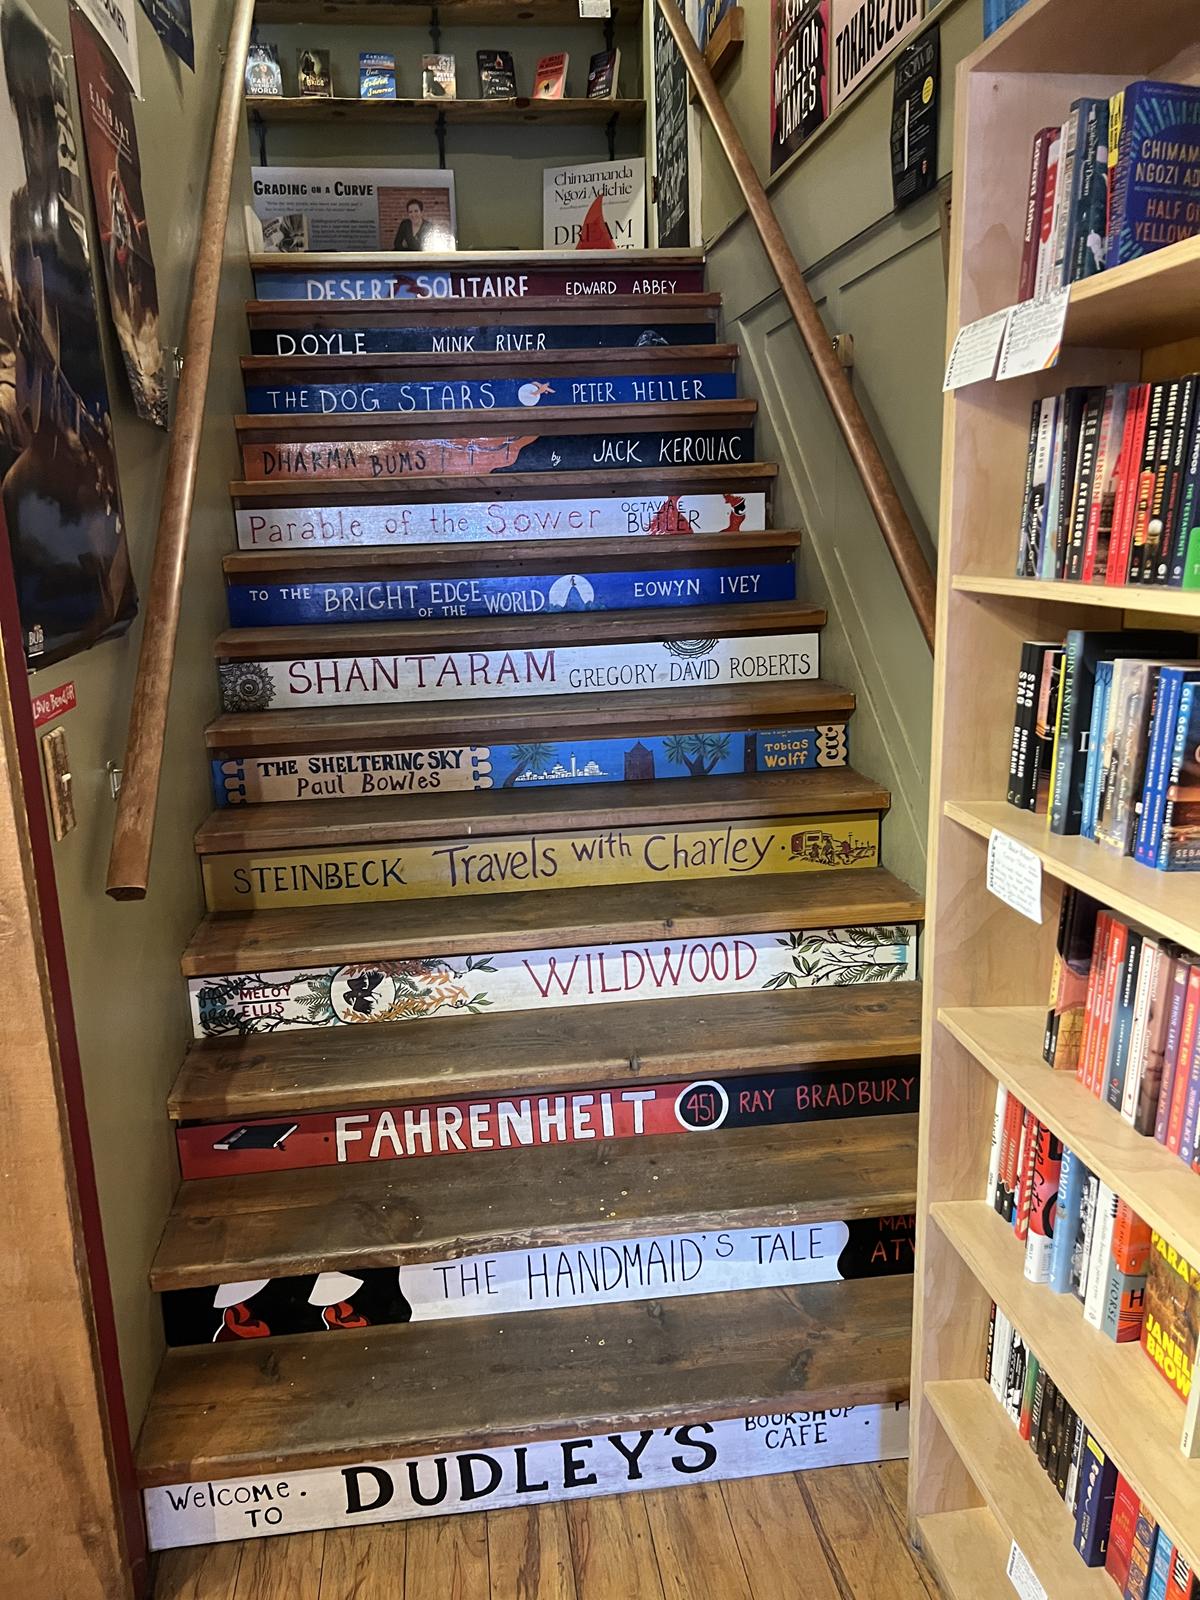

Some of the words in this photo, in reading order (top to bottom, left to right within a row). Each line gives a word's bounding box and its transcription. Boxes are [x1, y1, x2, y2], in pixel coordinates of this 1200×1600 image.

[774, 18, 819, 110] MARLON
[250, 86, 278, 95] WORLD
[778, 65, 818, 145] JAMES
[253, 180, 307, 197] GRADING
[334, 181, 374, 197] CURVE
[554, 165, 633, 186] Chimamanda
[1135, 162, 1178, 184] NGOZI
[555, 187, 587, 206] Ngozi
[588, 182, 633, 199] Adichie
[1146, 198, 1182, 222] HALF
[307, 279, 398, 300] DESERT
[416, 276, 529, 299] SOLITAIRE
[566, 280, 617, 296] EDWARD
[632, 279, 677, 295] ABBEY
[276, 333, 367, 356] DOYLE
[432, 336, 475, 353] MINK
[496, 333, 547, 352] RIVER
[267, 391, 309, 408] THE
[319, 388, 380, 414] DOG
[398, 383, 495, 412] STARS
[572, 383, 616, 403] PETER
[632, 380, 706, 401] HELLER
[1150, 385, 1163, 427] MARGARET
[1165, 384, 1179, 426] MARGARET
[1180, 381, 1191, 427] MARGARET
[262, 449, 357, 475] DHARMA
[369, 450, 427, 477] BUMS
[551, 451, 562, 467] by
[593, 440, 643, 464] JACK
[658, 436, 742, 464] KEROUAC
[1082, 443, 1093, 476] KATE
[1145, 430, 1157, 460] ATWOOD
[1160, 429, 1172, 460] ATWOOD
[1174, 429, 1185, 466] ATWOOD
[249, 511, 363, 544] Parable
[385, 510, 412, 535] of
[431, 508, 469, 533] the
[486, 503, 601, 534] Sower
[627, 510, 701, 533] BUTLER
[1073, 482, 1088, 547] ATKINSON
[249, 590, 269, 601] TO
[280, 588, 312, 600] THE
[323, 586, 418, 612] BRIGHT
[431, 581, 482, 603] EDGE
[484, 589, 545, 614] WORLD
[634, 579, 700, 598] EOWYN
[720, 574, 761, 594] IVEY
[418, 607, 433, 618] OF
[442, 605, 467, 617] THE
[288, 649, 557, 694] SHANTARAM
[569, 662, 658, 689] GREGORY
[669, 658, 720, 682] DAVID
[730, 653, 811, 679] ROBERTS
[1067, 642, 1076, 673] JOHN
[1061, 679, 1073, 739] BANVILLE
[1181, 688, 1190, 712] OLD
[764, 739, 809, 752] Tobias
[1174, 716, 1186, 751] GOD'S
[257, 760, 298, 777] THE
[309, 752, 425, 774] SHELTERING
[428, 750, 464, 770] SKY
[764, 751, 808, 768] Wolff
[297, 774, 345, 798] Paul
[361, 771, 441, 793] Bowles
[1054, 762, 1065, 806] Drowned
[233, 857, 407, 894] STEINBECK
[432, 837, 558, 888] Travels
[571, 832, 632, 862] with
[644, 826, 775, 871] Charley
[522, 940, 757, 998] WILDWOOD
[240, 985, 291, 1000] MELOY
[241, 1002, 285, 1018] ELLIS
[335, 1090, 657, 1163] FAHRENHEIT
[687, 1093, 715, 1122] 451
[739, 1089, 775, 1113] RAY
[796, 1077, 915, 1110] BRADBURY
[433, 1260, 498, 1299] THE
[527, 1233, 734, 1300] HANDMAID'S
[751, 1227, 824, 1265] TALE
[1107, 1278, 1120, 1324] HORSE
[1146, 1313, 1194, 1376] JANEL
[1146, 1334, 1193, 1398] BROW
[765, 1423, 828, 1449] CAFE
[166, 1481, 290, 1510] Welcome
[341, 1421, 717, 1515] DUDLEY'S
[245, 1506, 283, 1528] TO
